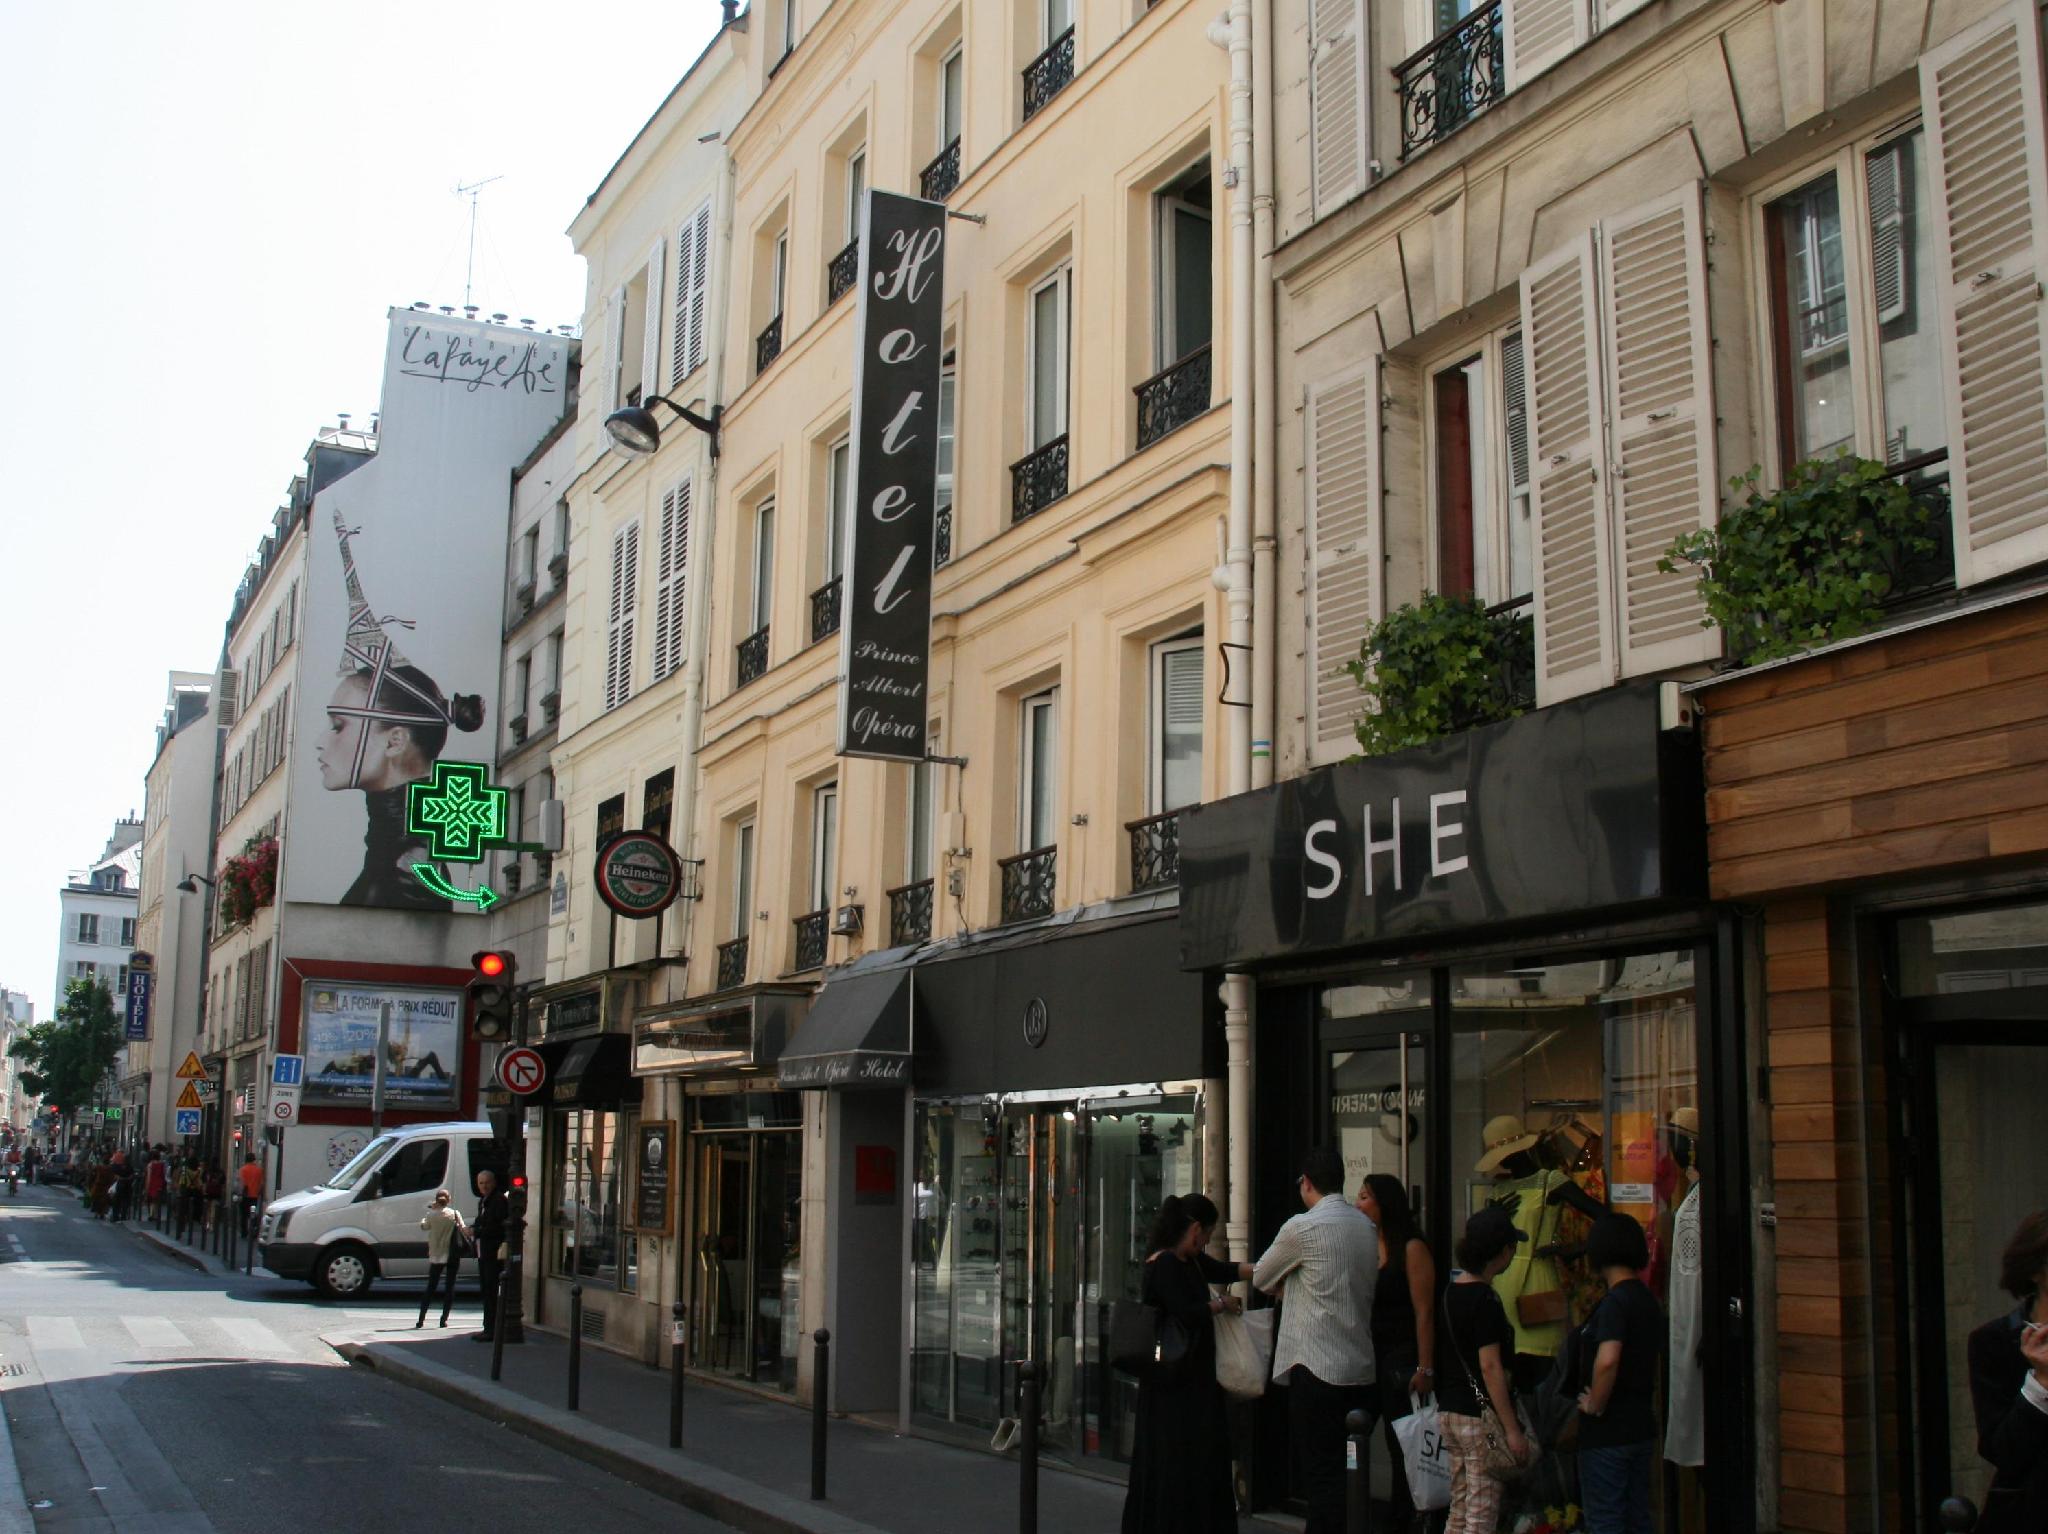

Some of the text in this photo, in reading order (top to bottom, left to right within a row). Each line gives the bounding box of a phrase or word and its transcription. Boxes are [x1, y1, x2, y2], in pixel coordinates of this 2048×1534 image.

[872, 226, 942, 615] Hotel
[854, 639, 920, 665] Prince
[853, 674, 921, 698] Albert
[852, 706, 919, 744] Opéra
[1305, 790, 1469, 899] SHE
[612, 864, 669, 882] Heineken
[133, 974, 145, 1026] HOTEL
[336, 993, 348, 1011] LA
[398, 999, 419, 1013] PRIX
[421, 998, 457, 1019] RÉDUIT
[859, 1058, 905, 1079] Hotel
[278, 1106, 288, 1115] 30
